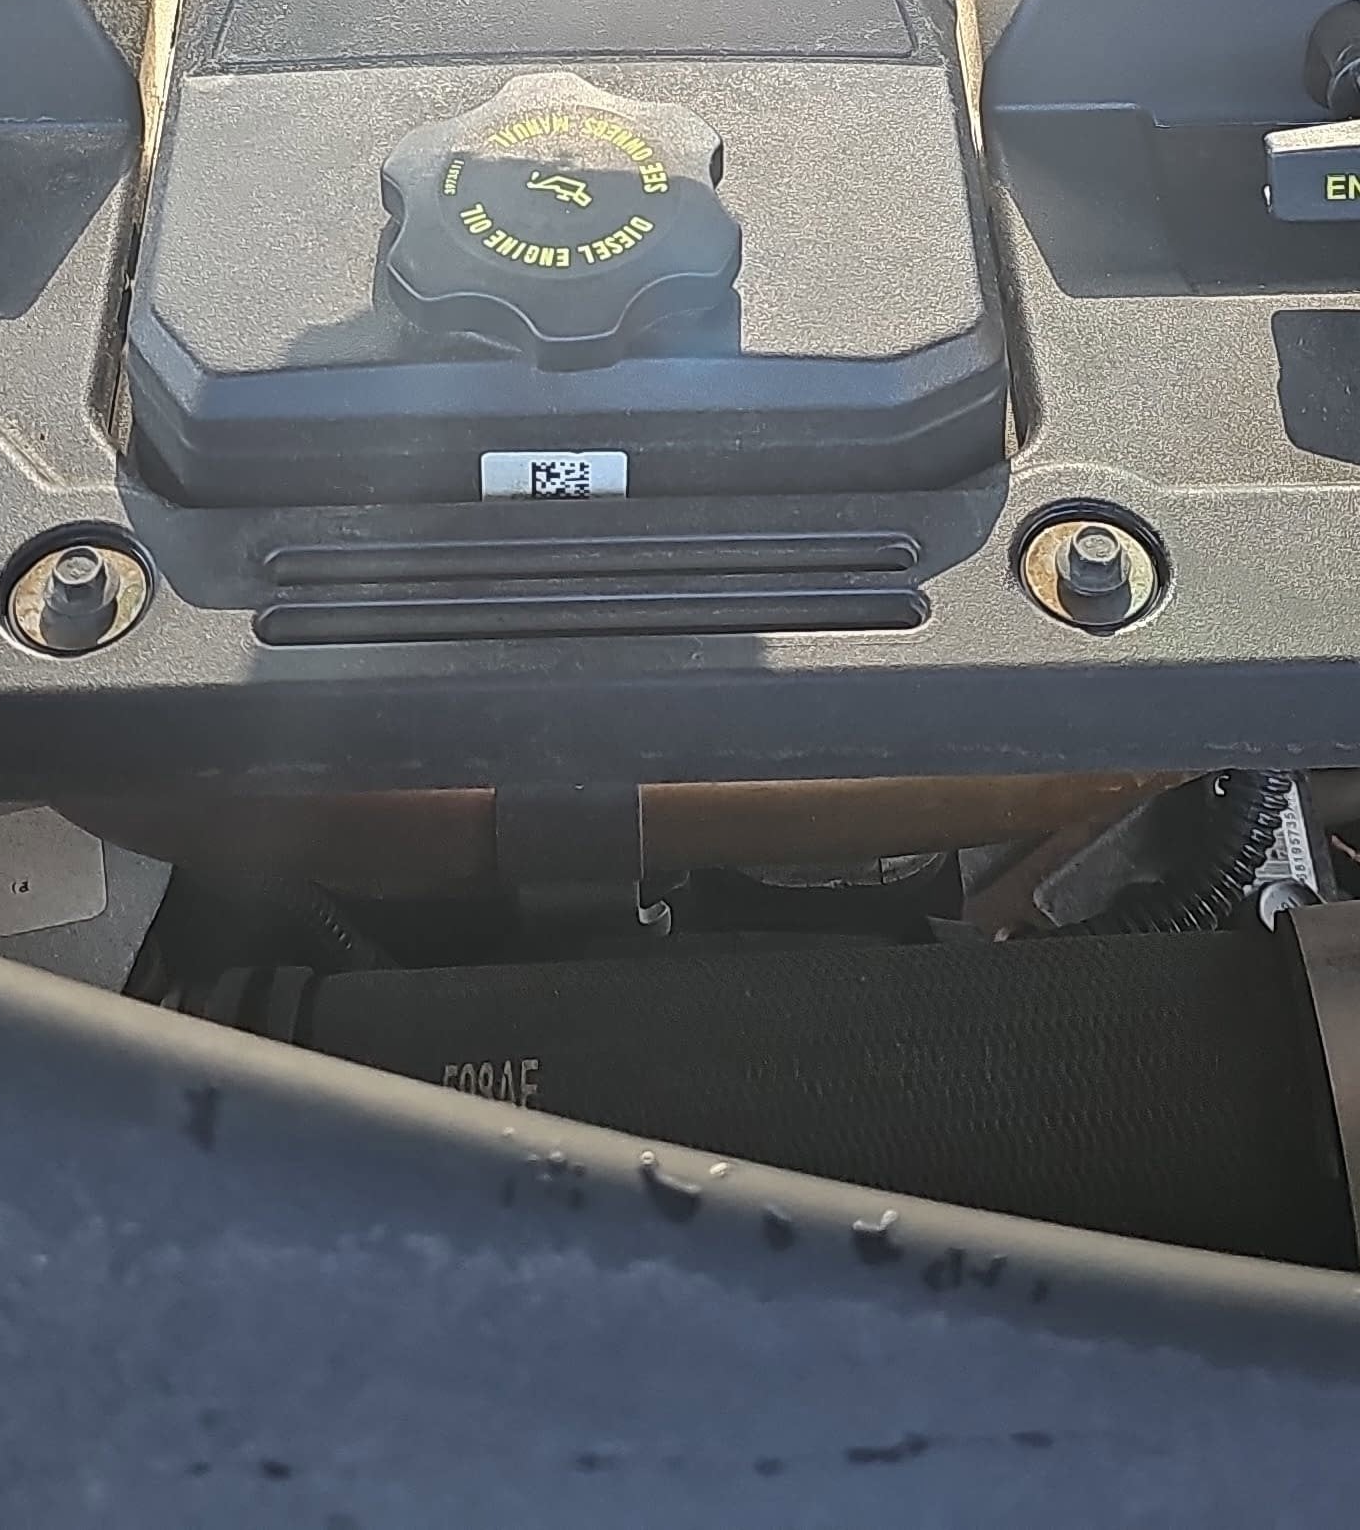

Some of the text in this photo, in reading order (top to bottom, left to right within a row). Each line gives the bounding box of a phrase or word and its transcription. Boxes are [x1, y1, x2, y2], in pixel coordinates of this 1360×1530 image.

[490, 114, 569, 149] MANUAL
[639, 161, 670, 194] SEE
[459, 202, 656, 267] DIESEL ENGINE OIL
